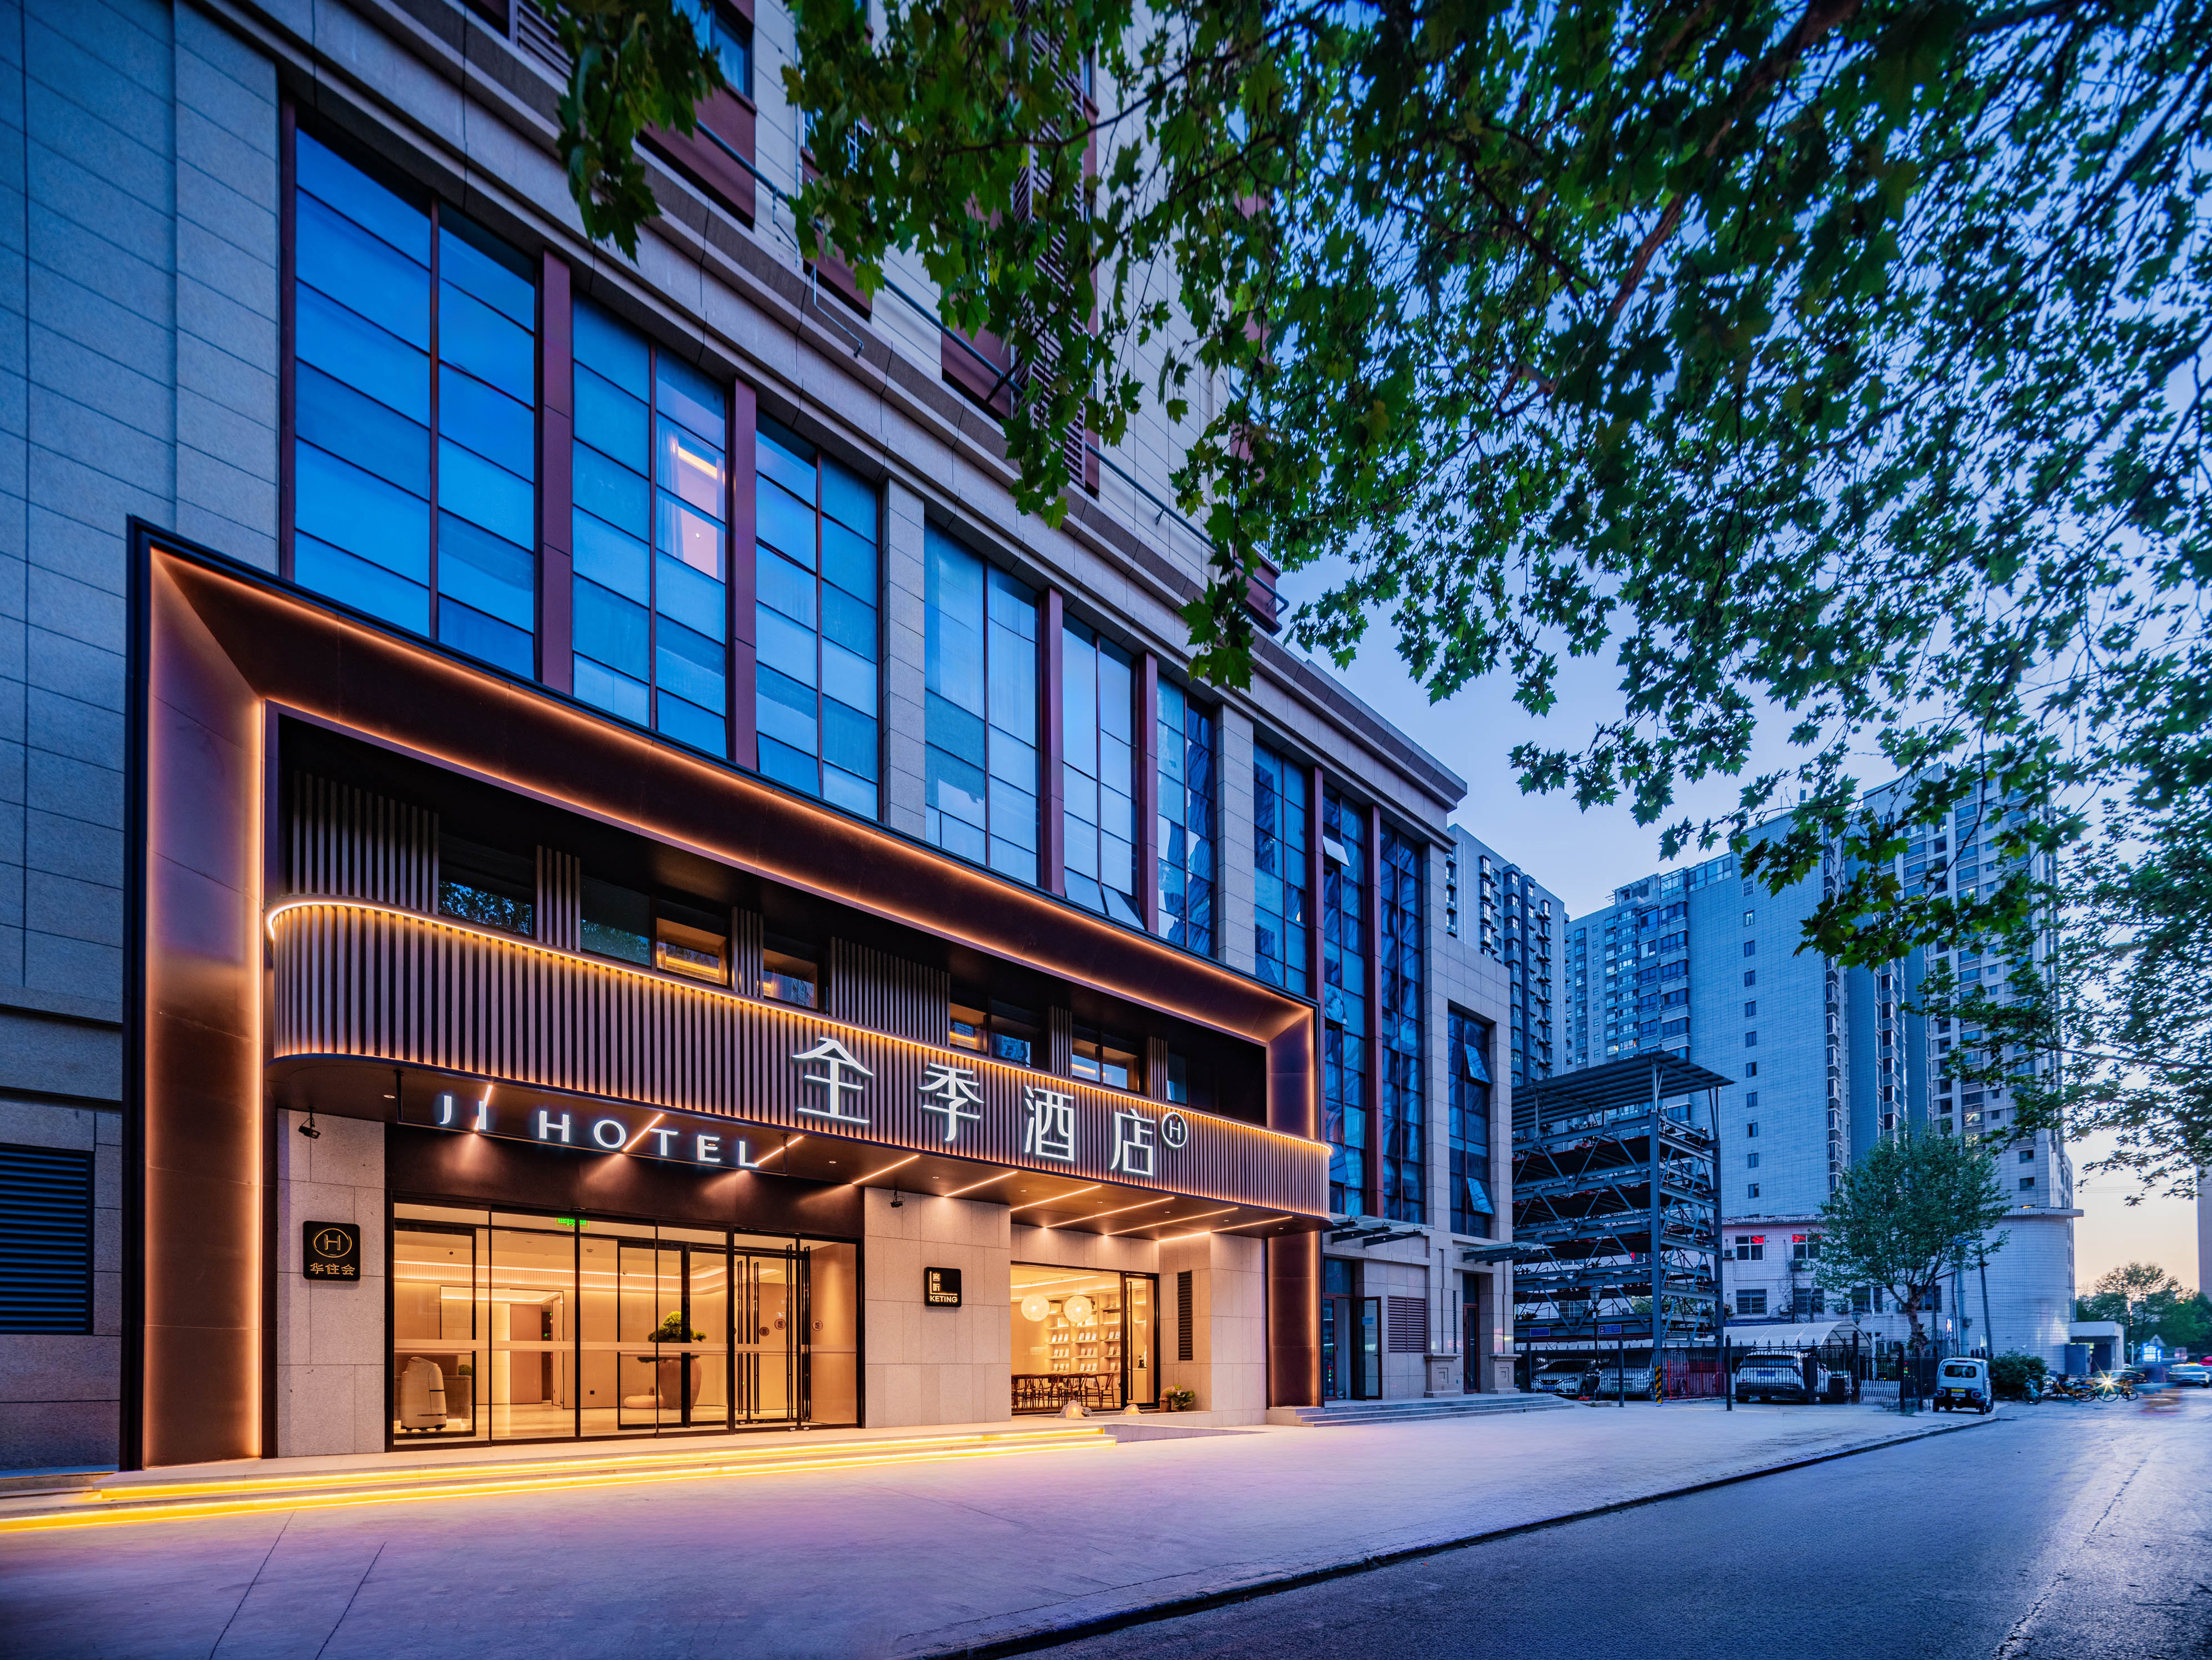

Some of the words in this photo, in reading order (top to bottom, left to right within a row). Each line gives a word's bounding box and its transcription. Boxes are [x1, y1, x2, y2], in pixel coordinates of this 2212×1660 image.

[439, 1095, 487, 1130] JI
[539, 1110, 759, 1168] HOTEL
[792, 1037, 1156, 1177] 全季酒店
[310, 1262, 356, 1276] 华住会
